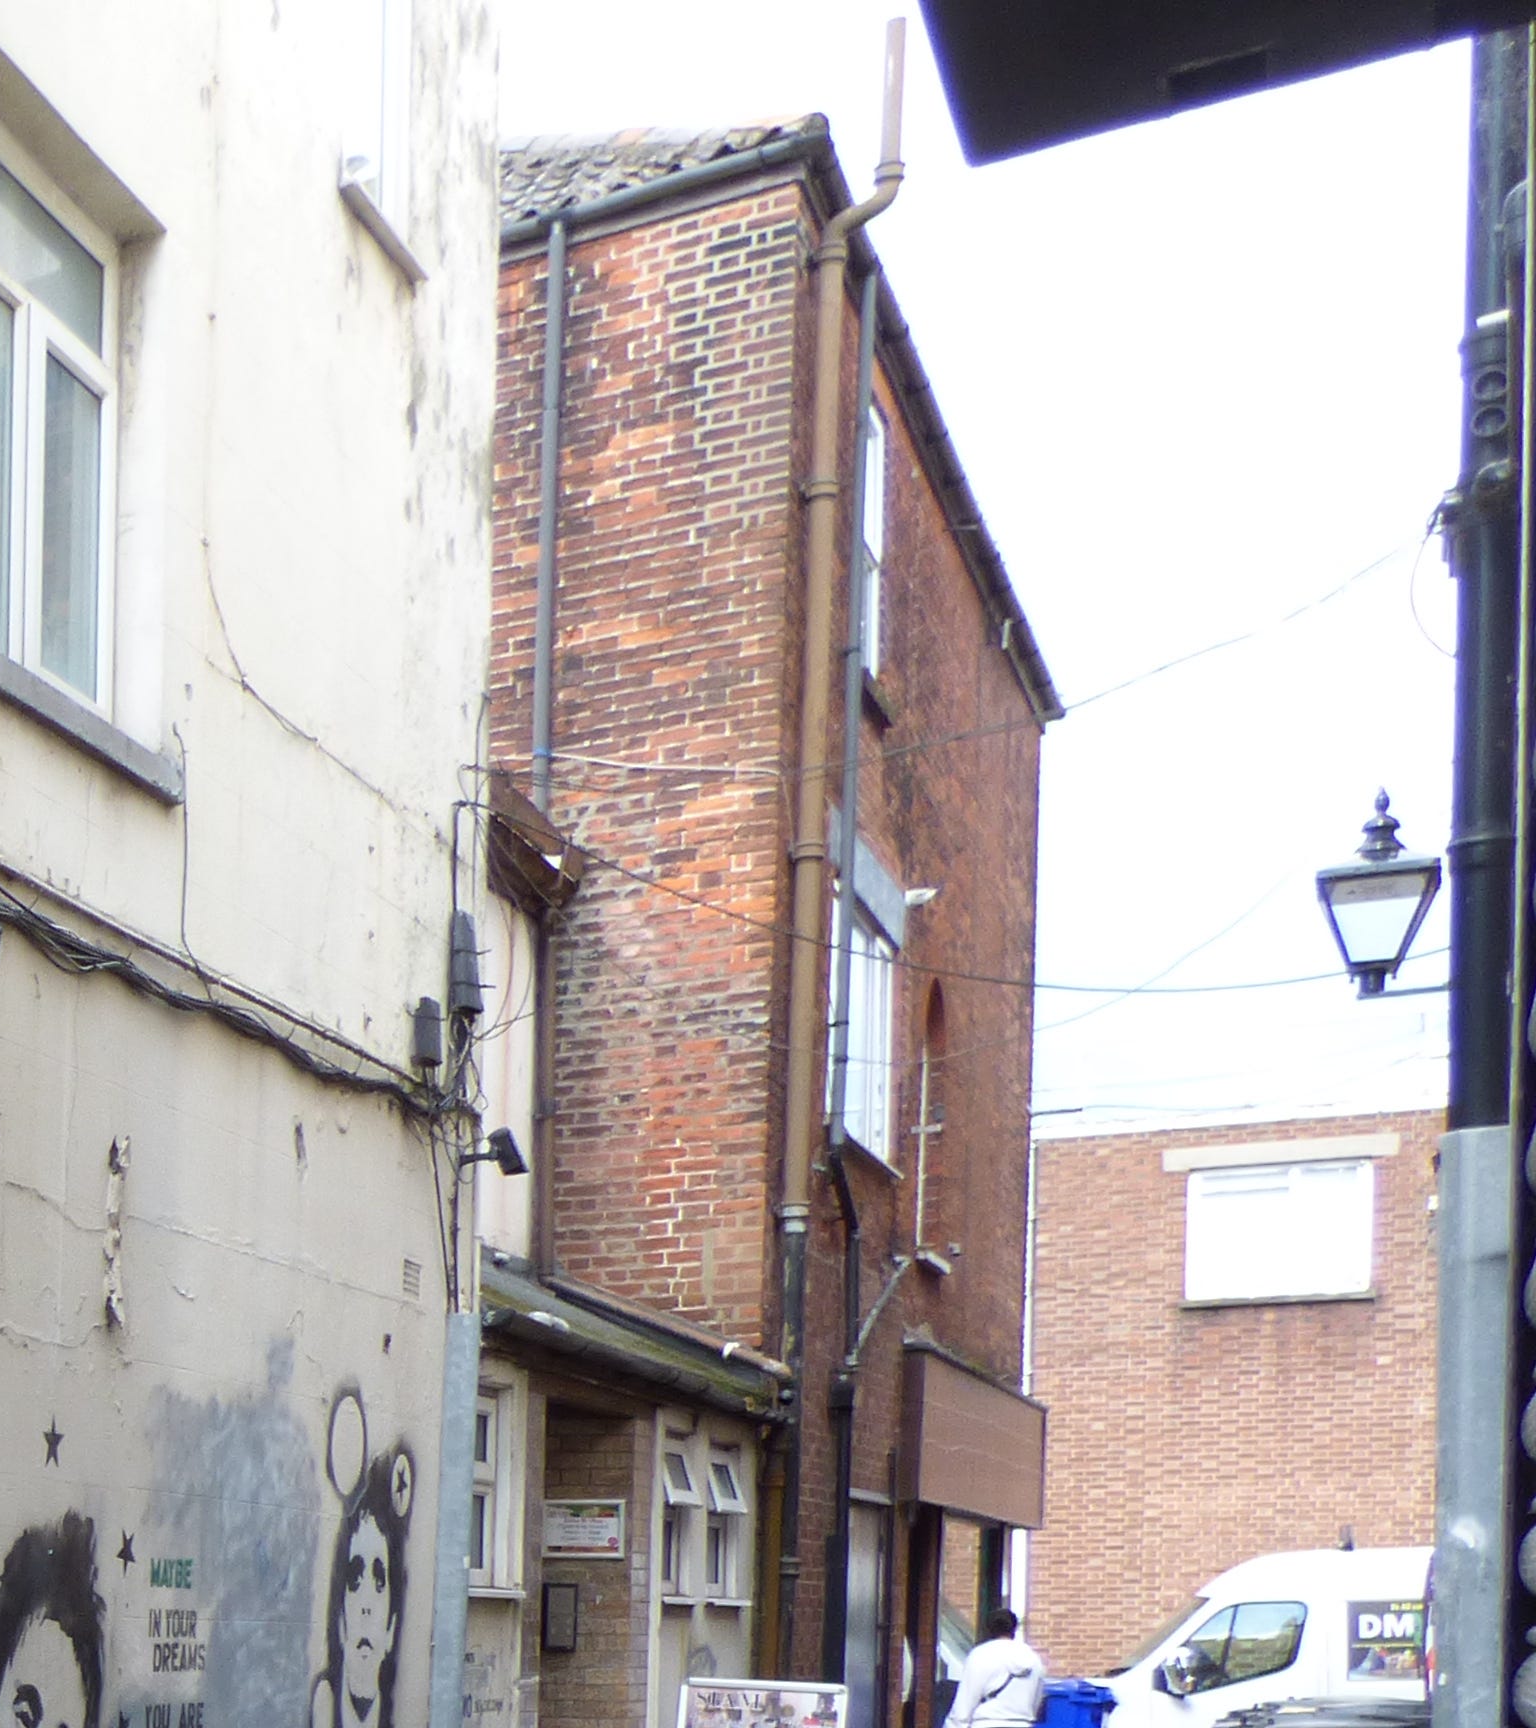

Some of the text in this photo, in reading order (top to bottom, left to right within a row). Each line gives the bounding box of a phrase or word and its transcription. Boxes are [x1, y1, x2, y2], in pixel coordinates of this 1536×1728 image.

[150, 1558, 194, 1589] MAYBE
[148, 1608, 198, 1640] IN YOUR
[152, 1643, 206, 1673] DREAMS
